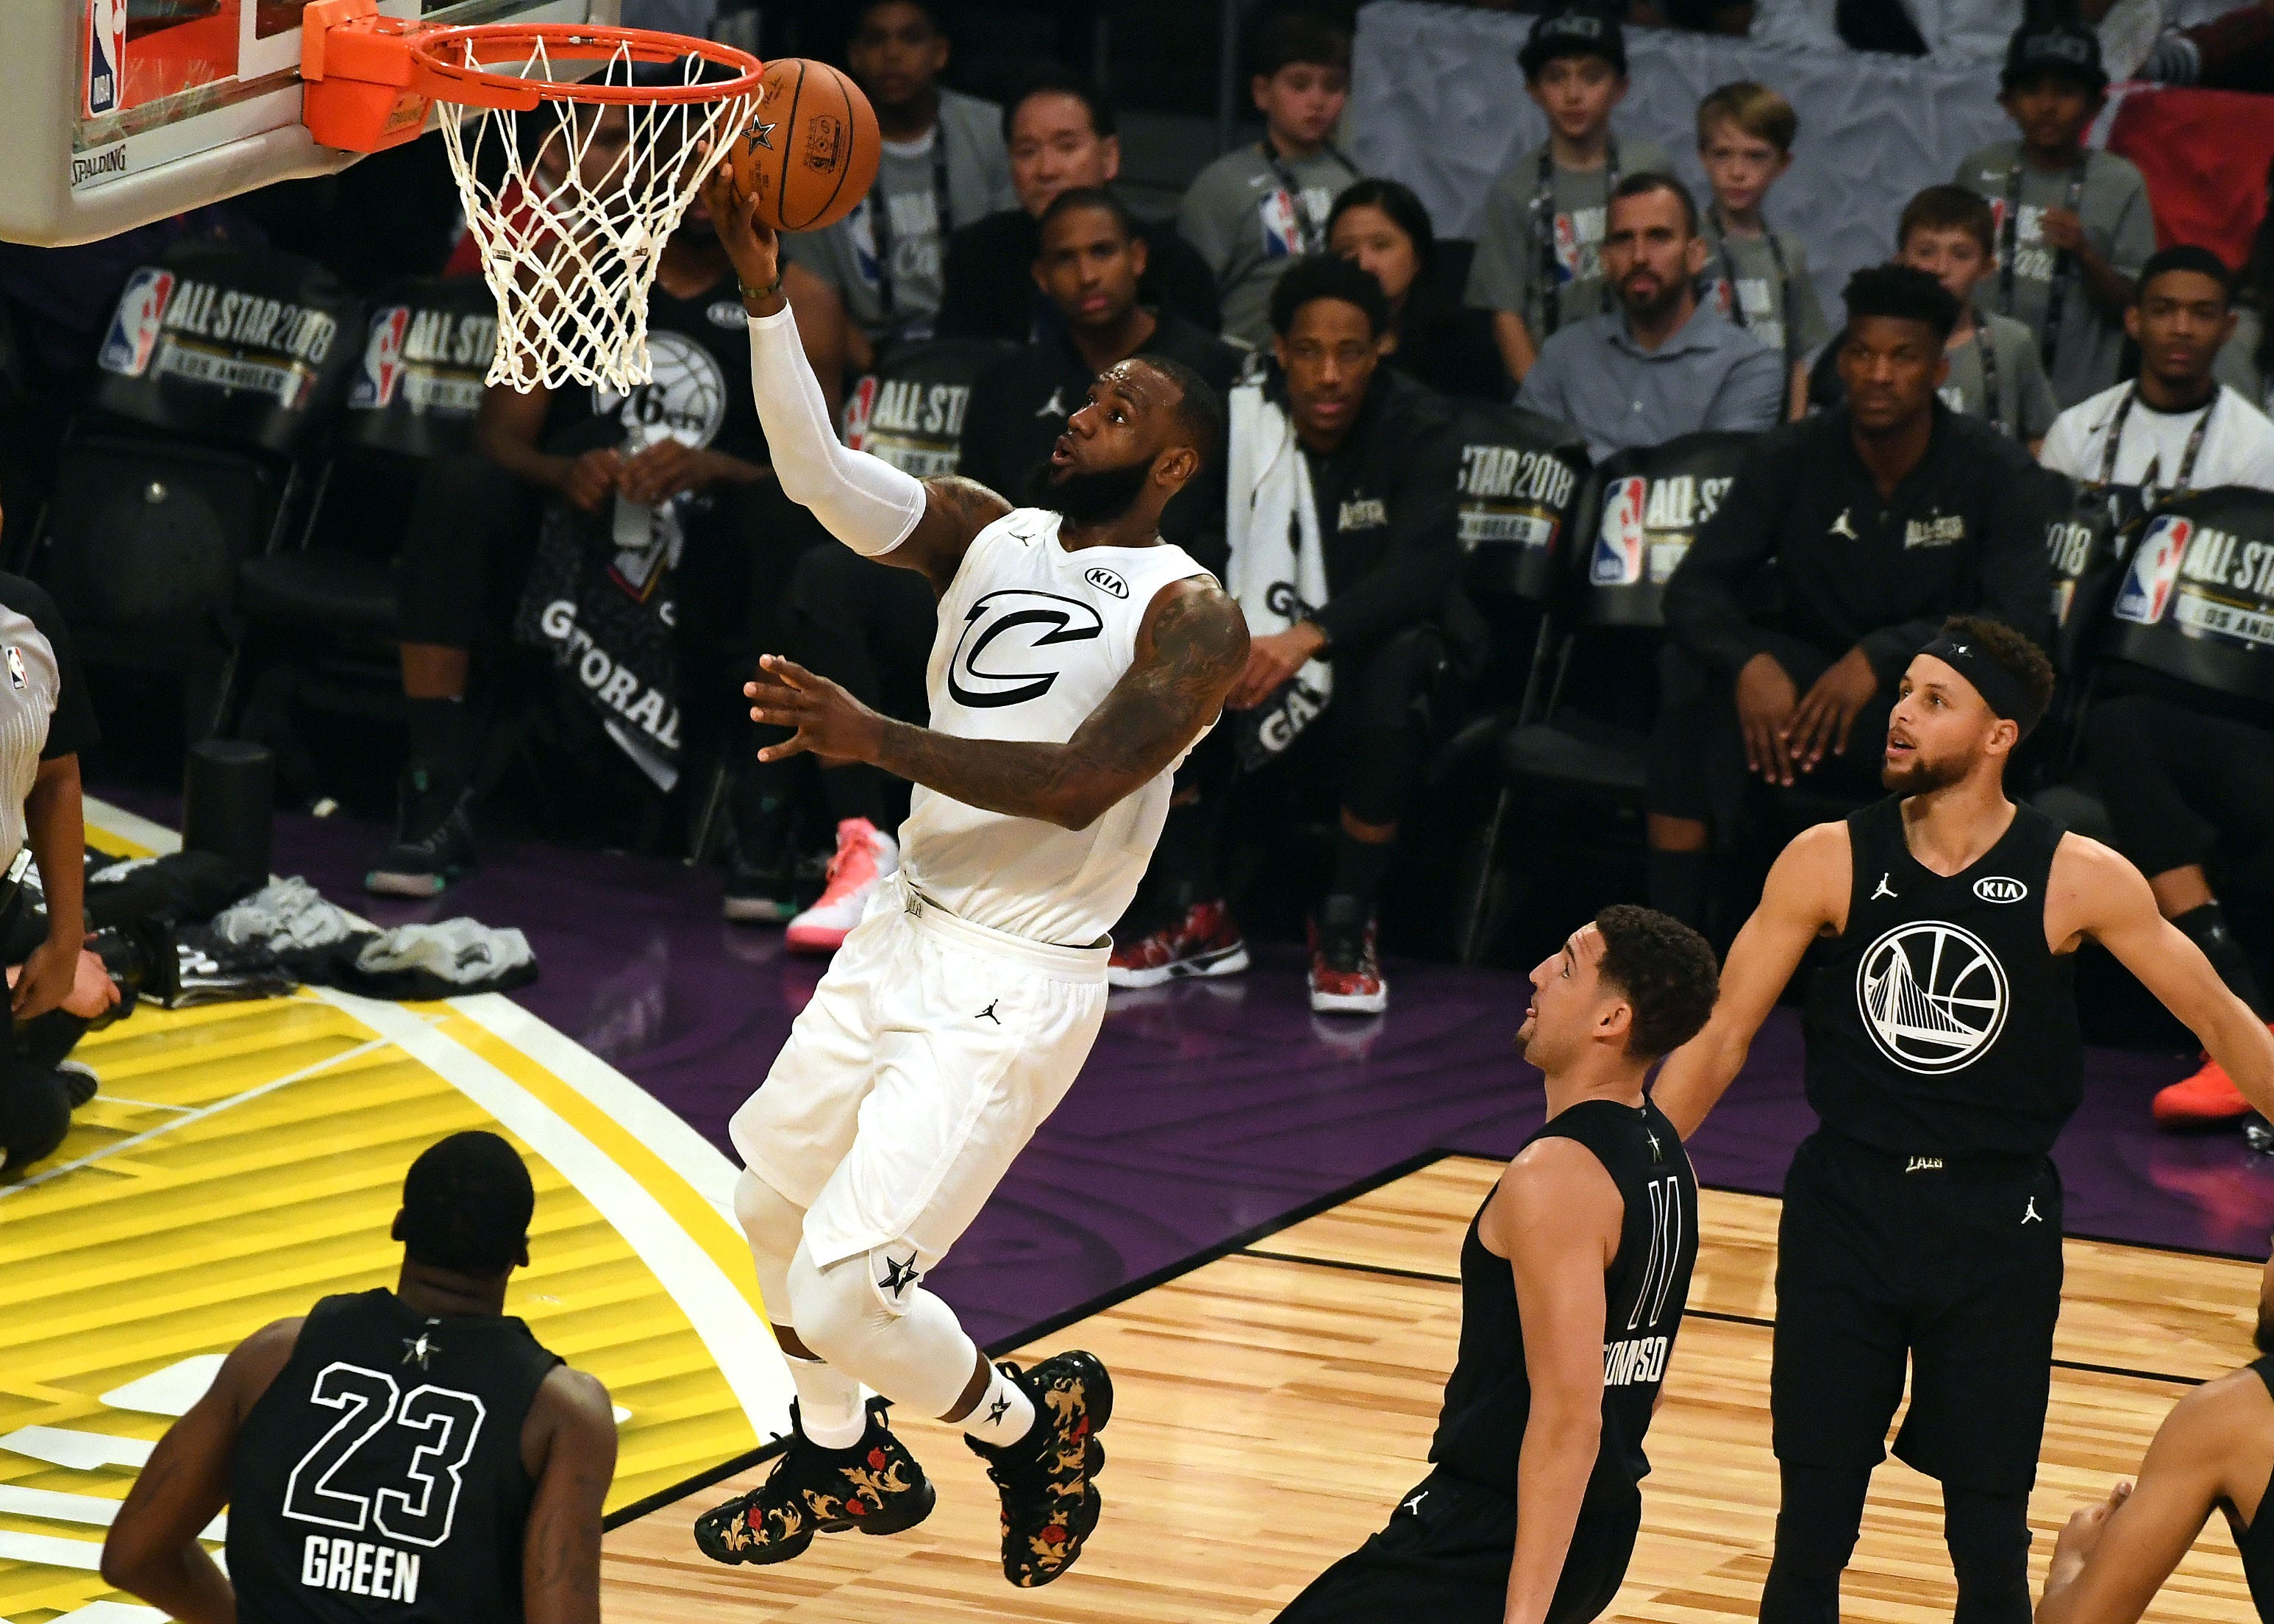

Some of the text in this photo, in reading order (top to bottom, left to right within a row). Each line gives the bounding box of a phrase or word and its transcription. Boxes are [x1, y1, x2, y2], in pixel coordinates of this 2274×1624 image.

[72, 144, 126, 185] SPALDING
[1090, 569, 1122, 595] KIA
[1983, 882, 2018, 898] KIA
[1628, 1176, 1681, 1331] 11
[282, 1361, 486, 1548] 23
[302, 1535, 421, 1603] GREEN
